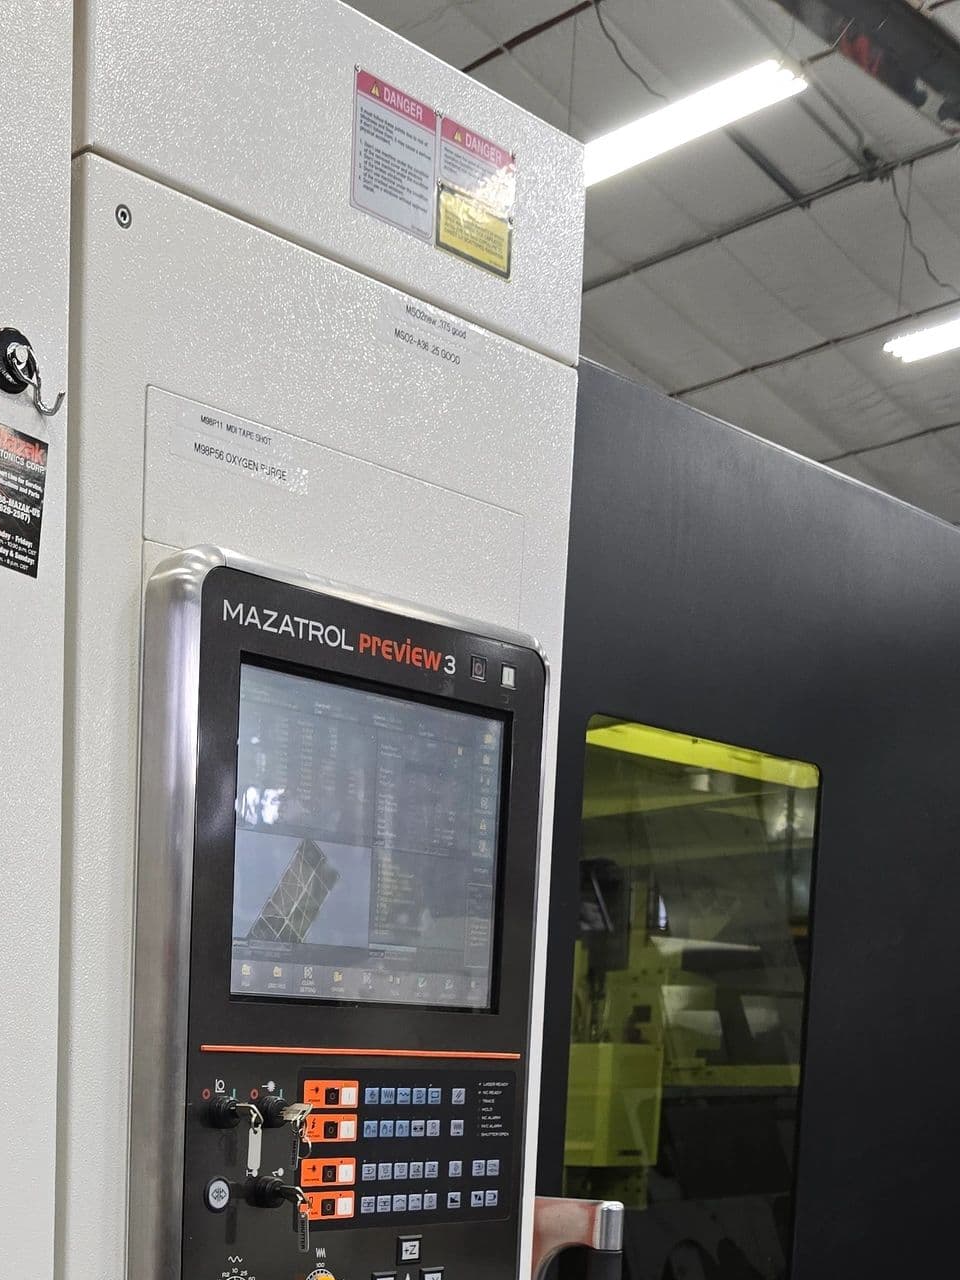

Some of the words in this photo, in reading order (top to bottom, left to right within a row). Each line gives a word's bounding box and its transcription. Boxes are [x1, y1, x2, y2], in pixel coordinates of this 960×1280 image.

[383, 87, 423, 121] DANGER
[465, 133, 503, 164] DANGER
[441, 349, 461, 365] GOOD
[226, 424, 238, 435] MDI
[239, 428, 254, 441] TAPE
[255, 434, 272, 446] SHOT
[194, 442, 225, 461] M98P56
[226, 453, 259, 472] OXYGEN
[261, 463, 287, 481] PURGE
[223, 599, 354, 652] MAZATROL
[444, 655, 456, 675] 3
[404, 1244, 417, 1255] +Z
